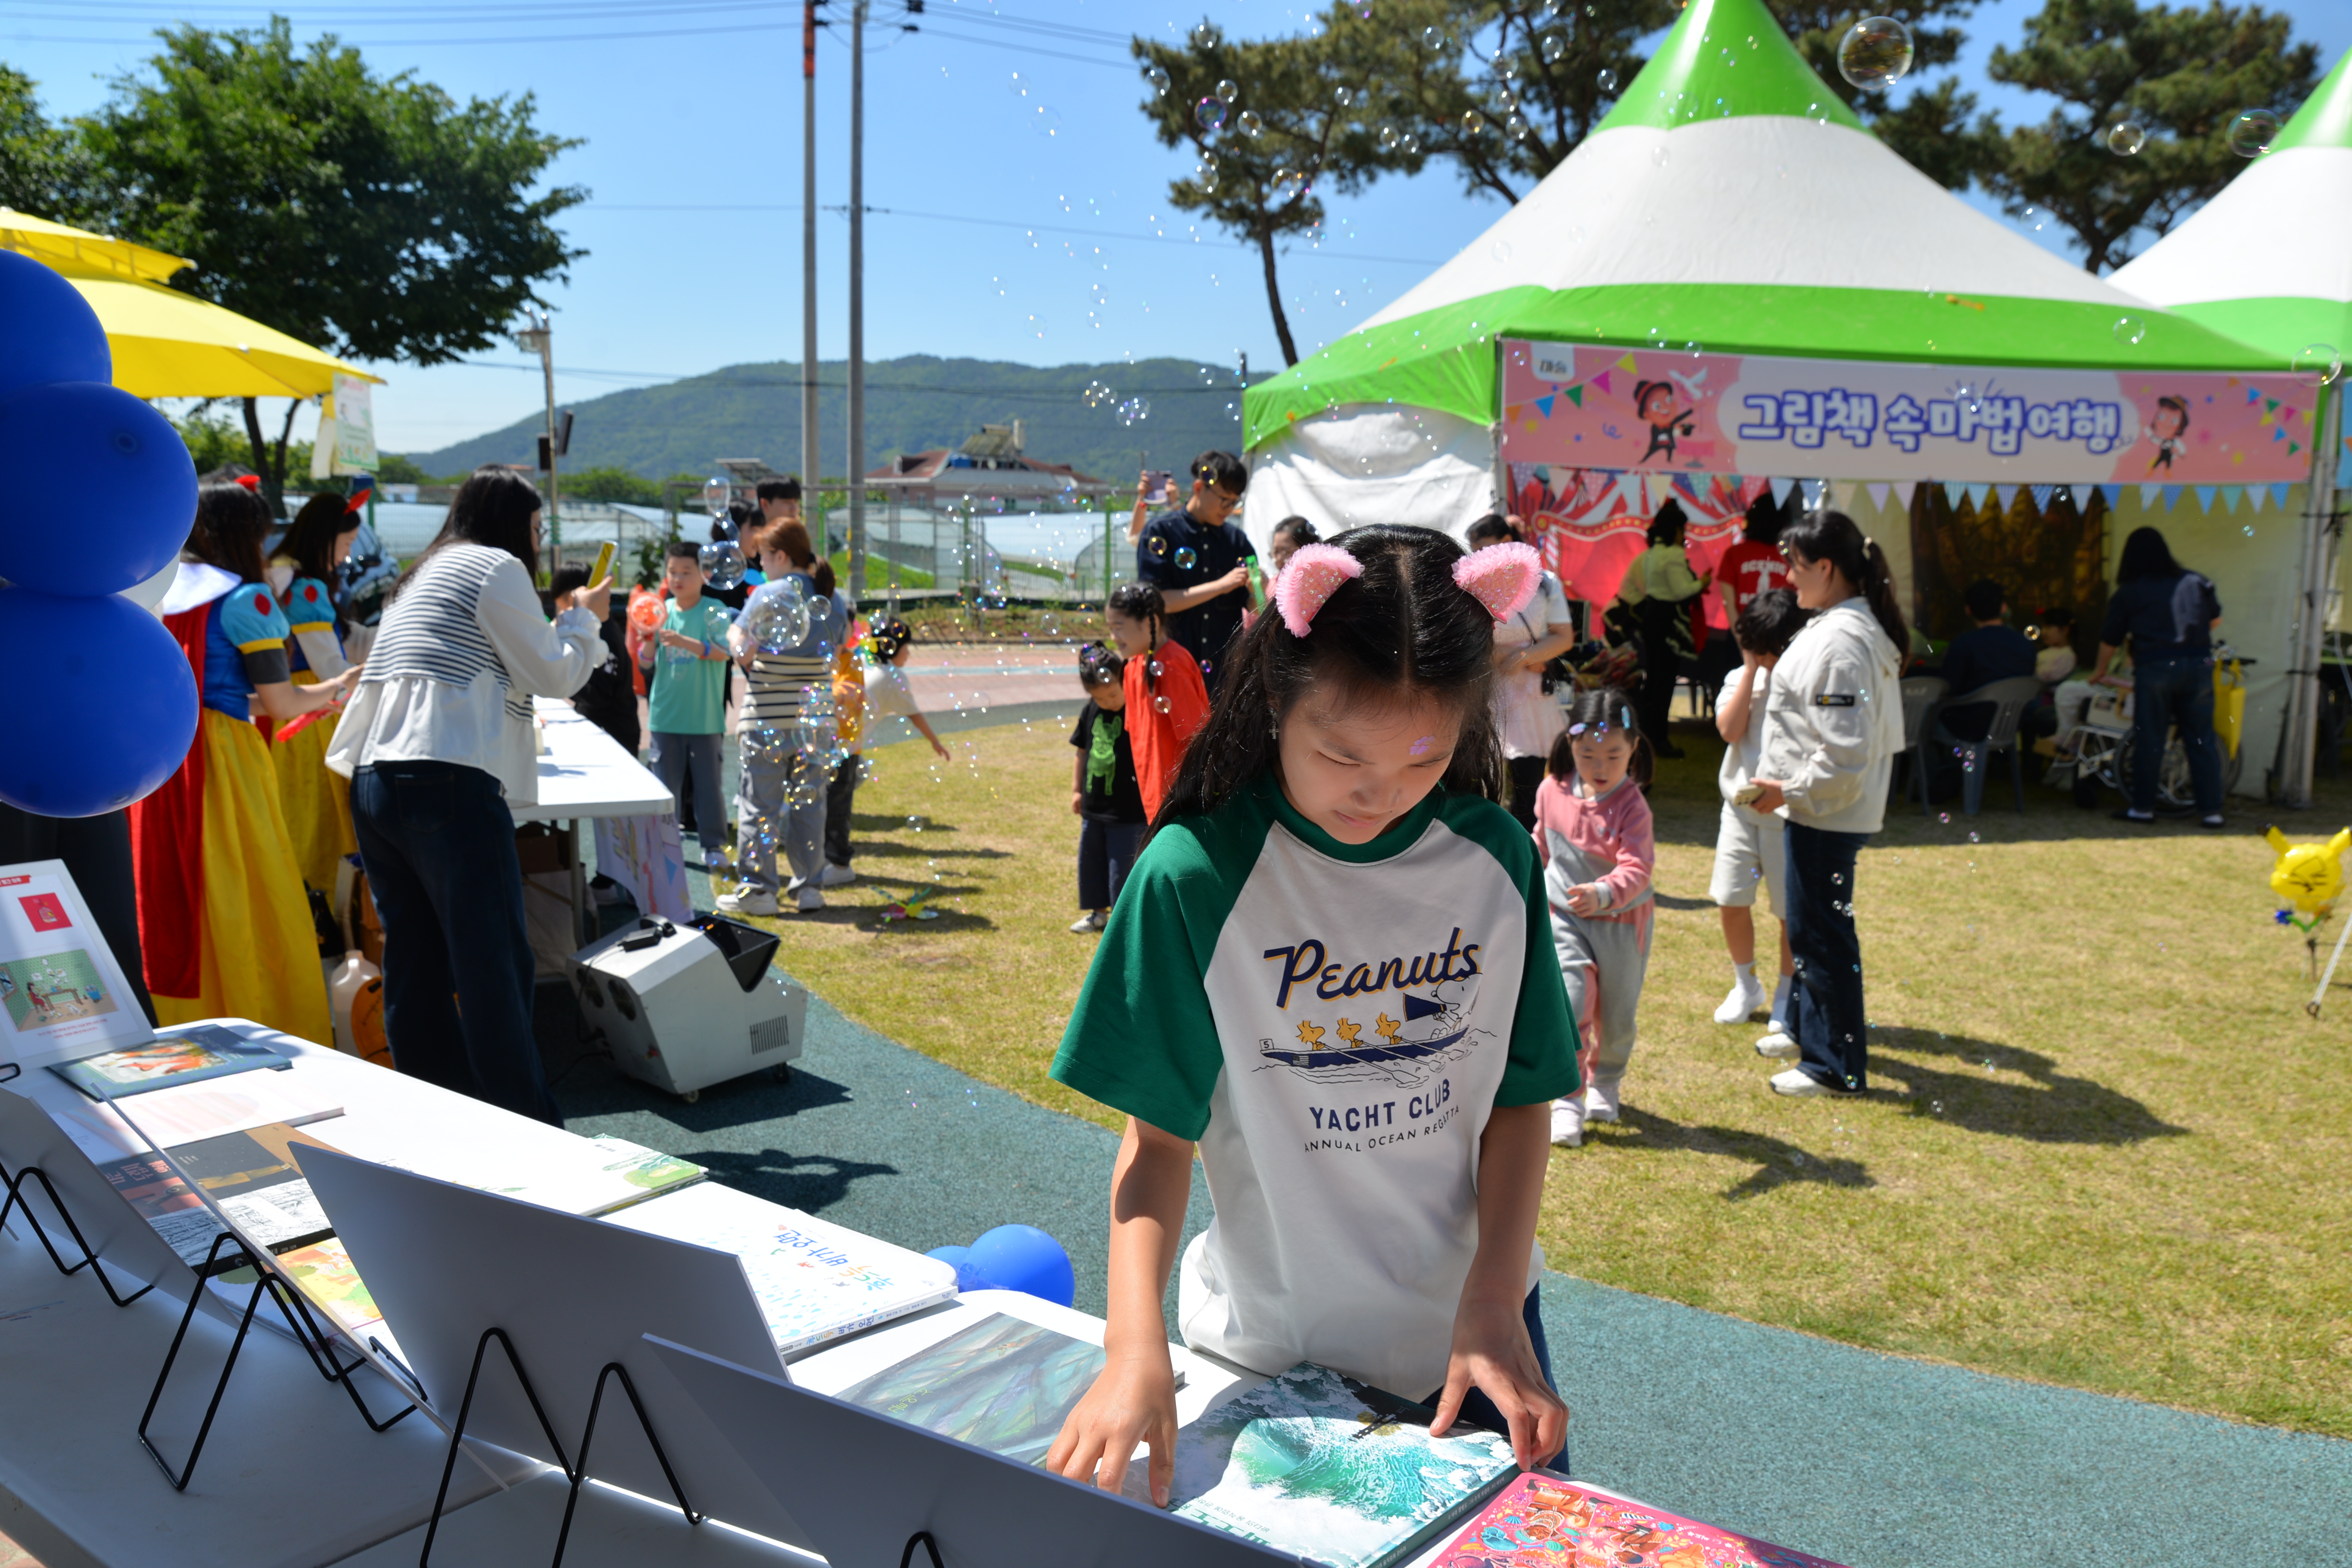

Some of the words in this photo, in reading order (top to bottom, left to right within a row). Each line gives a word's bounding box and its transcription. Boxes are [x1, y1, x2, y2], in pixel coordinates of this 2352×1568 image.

[1739, 388, 1878, 448] 그림책
[1885, 393, 1928, 452] 속
[1928, 396, 2026, 455] 마법
[2026, 398, 2121, 455] 여행
[1263, 926, 1481, 1011] Peanuts
[1263, 1040, 1270, 1049] 5
[1309, 1101, 1395, 1132] YACHT
[1409, 1078, 1450, 1119] CLUB
[1304, 1140, 1361, 1153] ANNUAL
[1368, 1129, 1416, 1148] OCEAN
[1424, 1105, 1459, 1136] REGATTA
[806, 1247, 849, 1266] 비가
[1190, 1495, 1214, 1508] 관하여
[1213, 1505, 1245, 1522] 움직임에
[1245, 1520, 1270, 1533] 바다의
